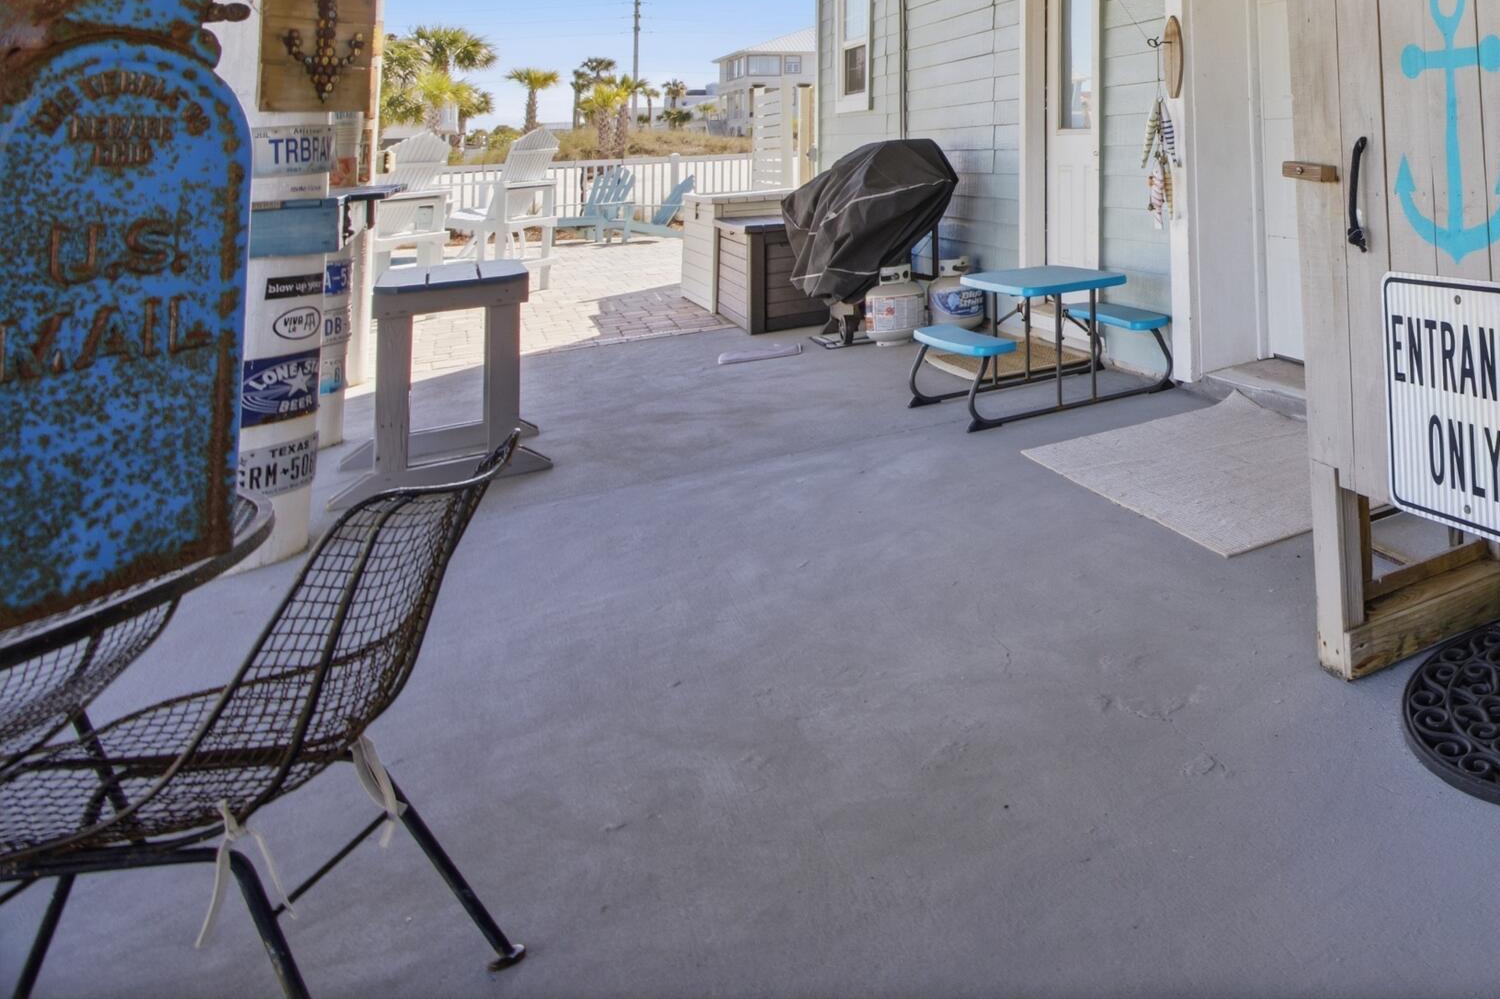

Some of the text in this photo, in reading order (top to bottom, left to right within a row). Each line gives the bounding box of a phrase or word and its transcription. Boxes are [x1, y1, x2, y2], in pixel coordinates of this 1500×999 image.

[249, 361, 298, 391] LONE
[278, 395, 313, 414] BEER
[270, 439, 310, 459] TEXAS
